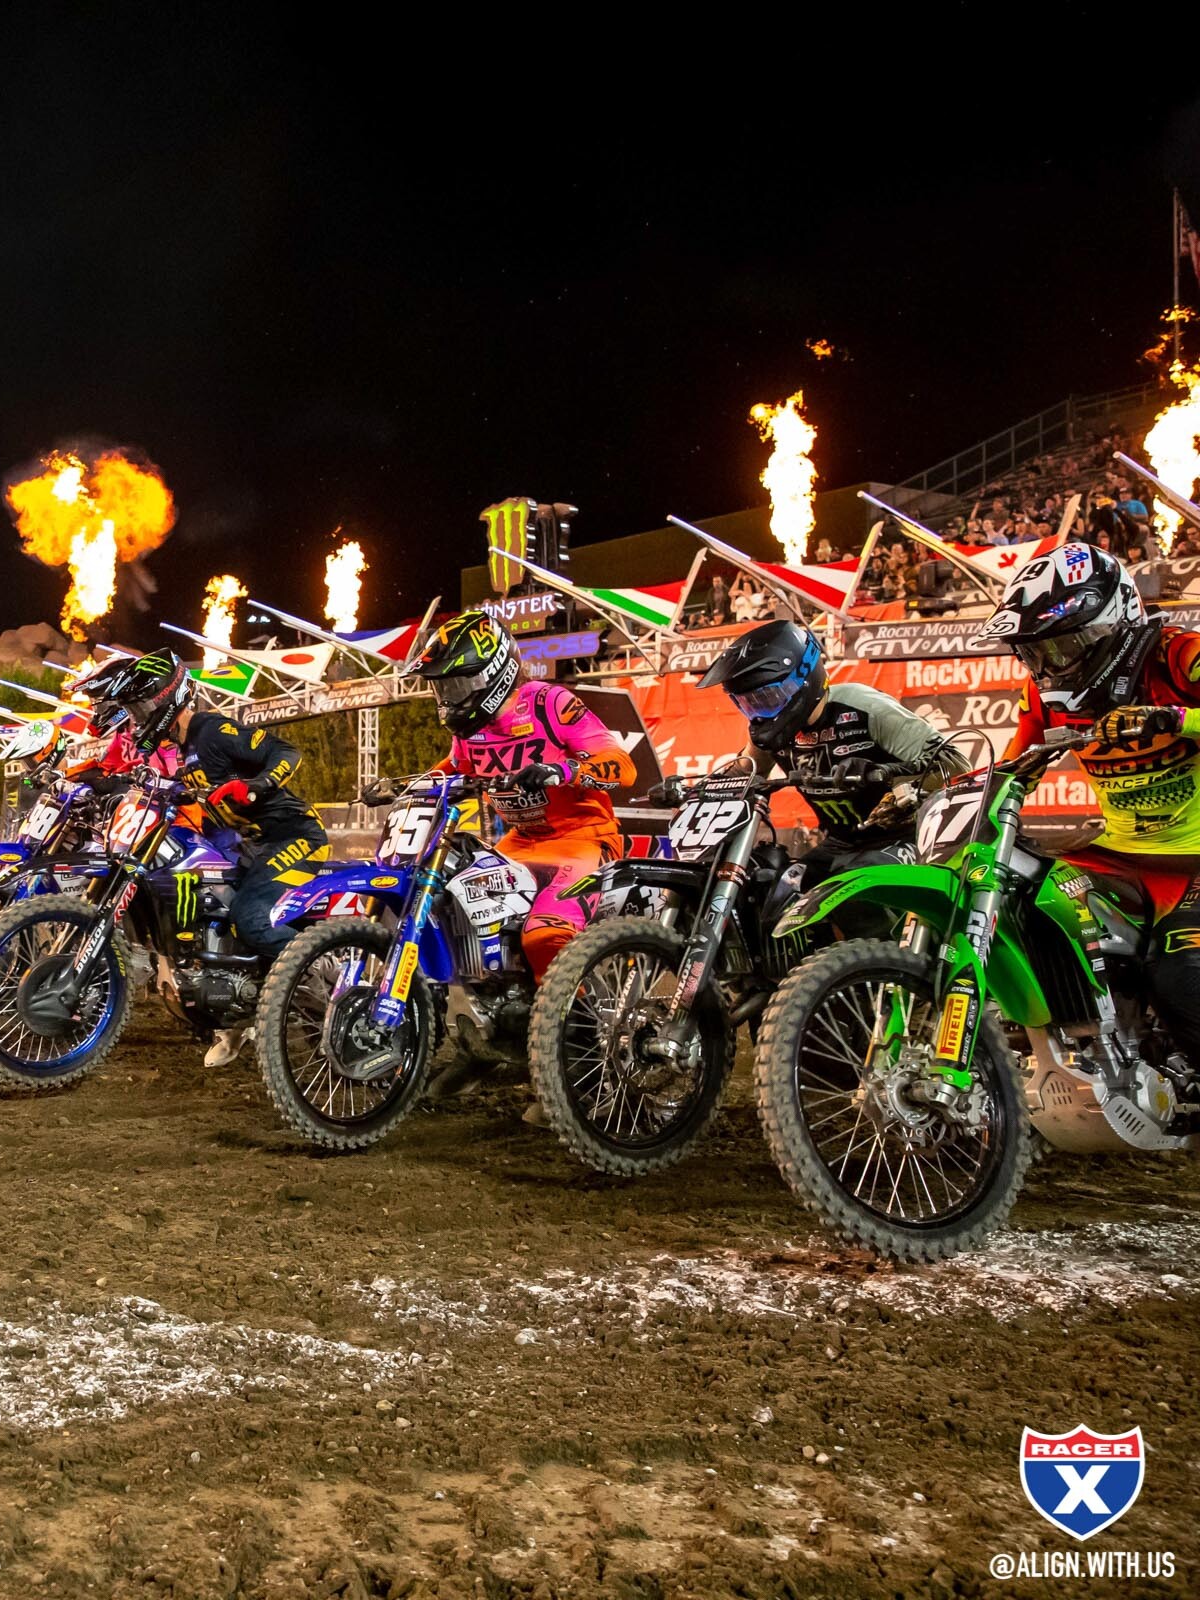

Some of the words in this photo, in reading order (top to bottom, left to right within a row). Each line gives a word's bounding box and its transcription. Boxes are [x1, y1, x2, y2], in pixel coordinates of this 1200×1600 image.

[685, 641, 719, 652] ROCKY
[876, 626, 920, 639] ROCKY
[705, 781, 748, 791] RENTHAL
[109, 804, 157, 845] 28
[378, 807, 438, 858] 35
[668, 801, 745, 848] 432
[266, 838, 313, 872] THOR
[76, 919, 106, 974] DUNLOP
[397, 947, 417, 995] PIRELLI
[668, 958, 692, 1021] DUNLOP
[940, 998, 964, 1056] PIRELLI
